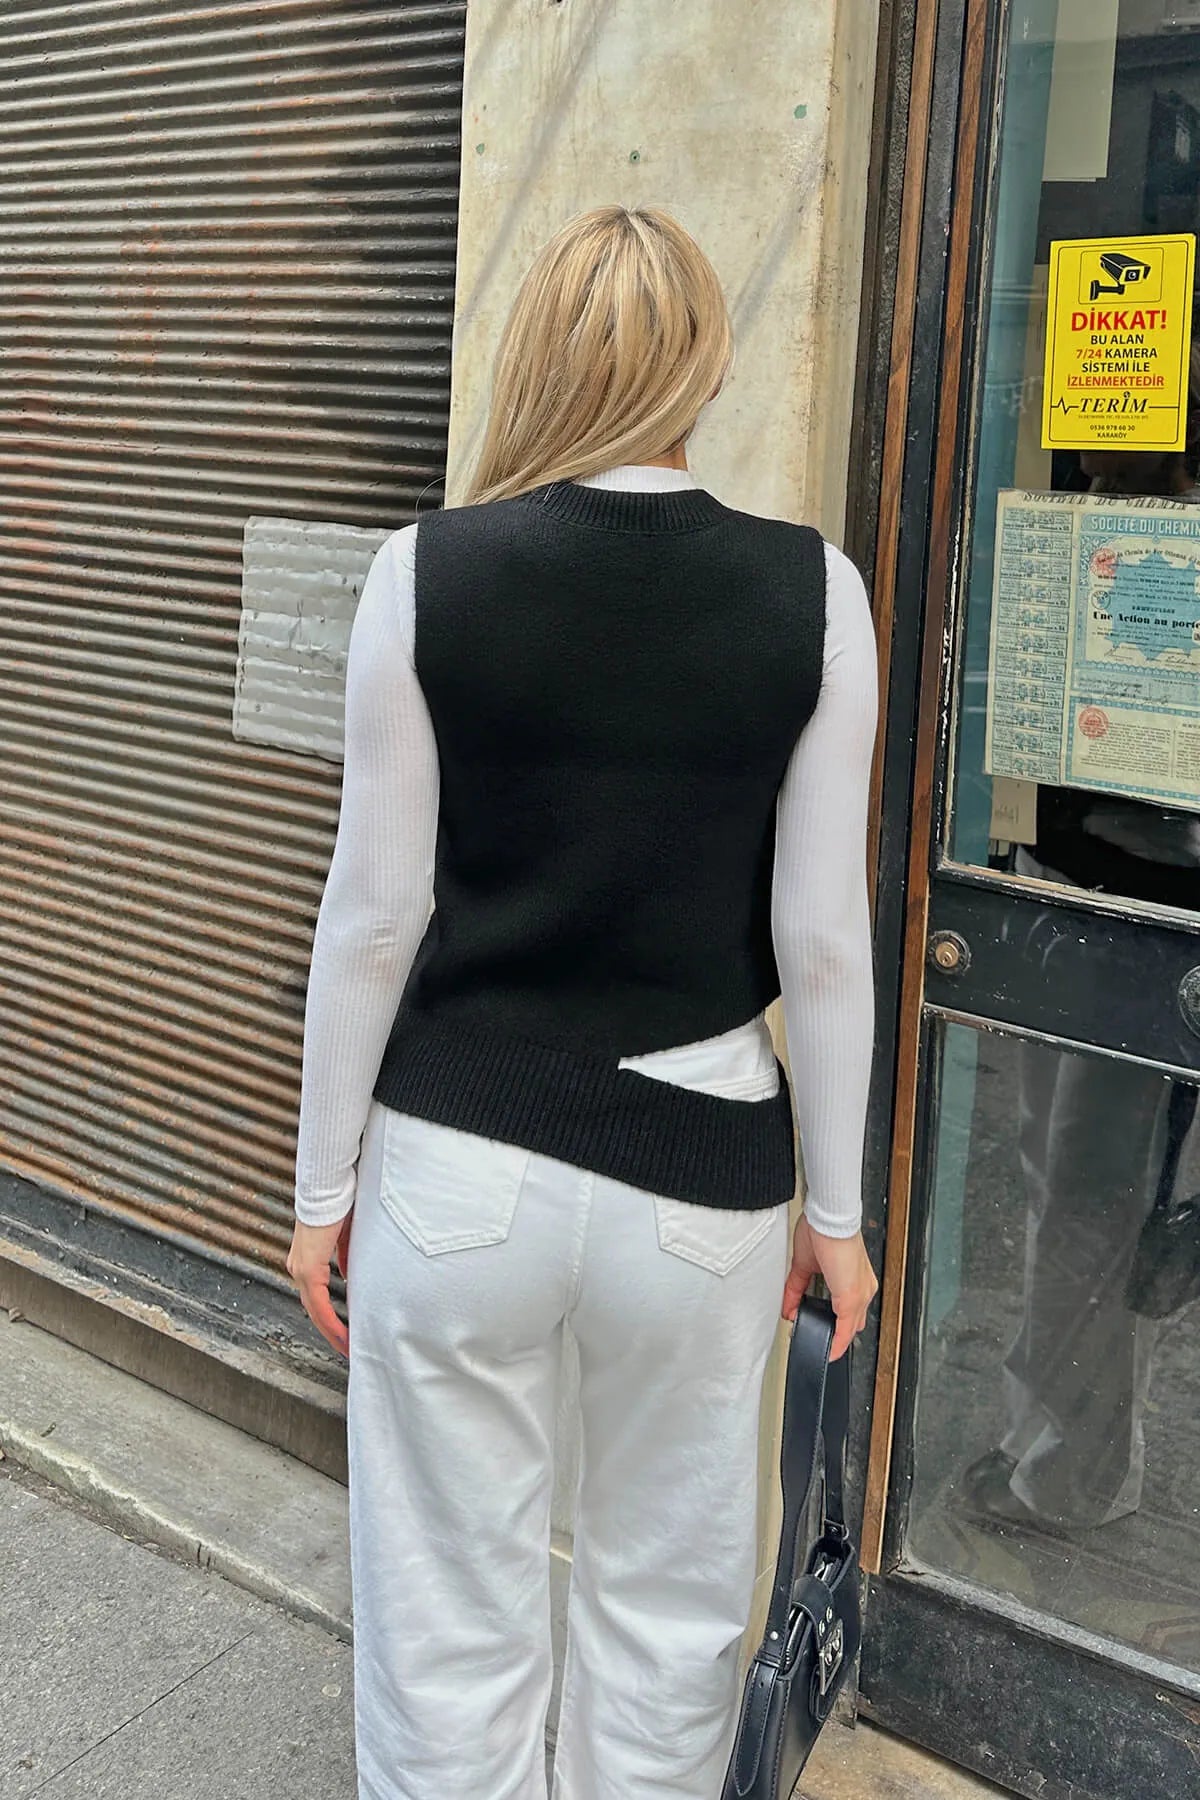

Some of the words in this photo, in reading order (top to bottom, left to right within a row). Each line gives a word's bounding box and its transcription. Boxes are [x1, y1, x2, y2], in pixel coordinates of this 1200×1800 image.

[1071, 307, 1167, 332] DİKKAT!
[1090, 334, 1107, 345] BU
[1111, 334, 1145, 345] ALAN
[1076, 348, 1102, 359] 7/24
[1105, 347, 1158, 359] KAMERA
[1081, 361, 1130, 373] SİSTEMİ
[1132, 361, 1151, 373] İLE
[1067, 375, 1165, 387] İZLENMEKTEDİR
[1079, 391, 1150, 414] TERİM
[1139, 518, 1156, 534] DU
[1118, 613, 1150, 624] Action
